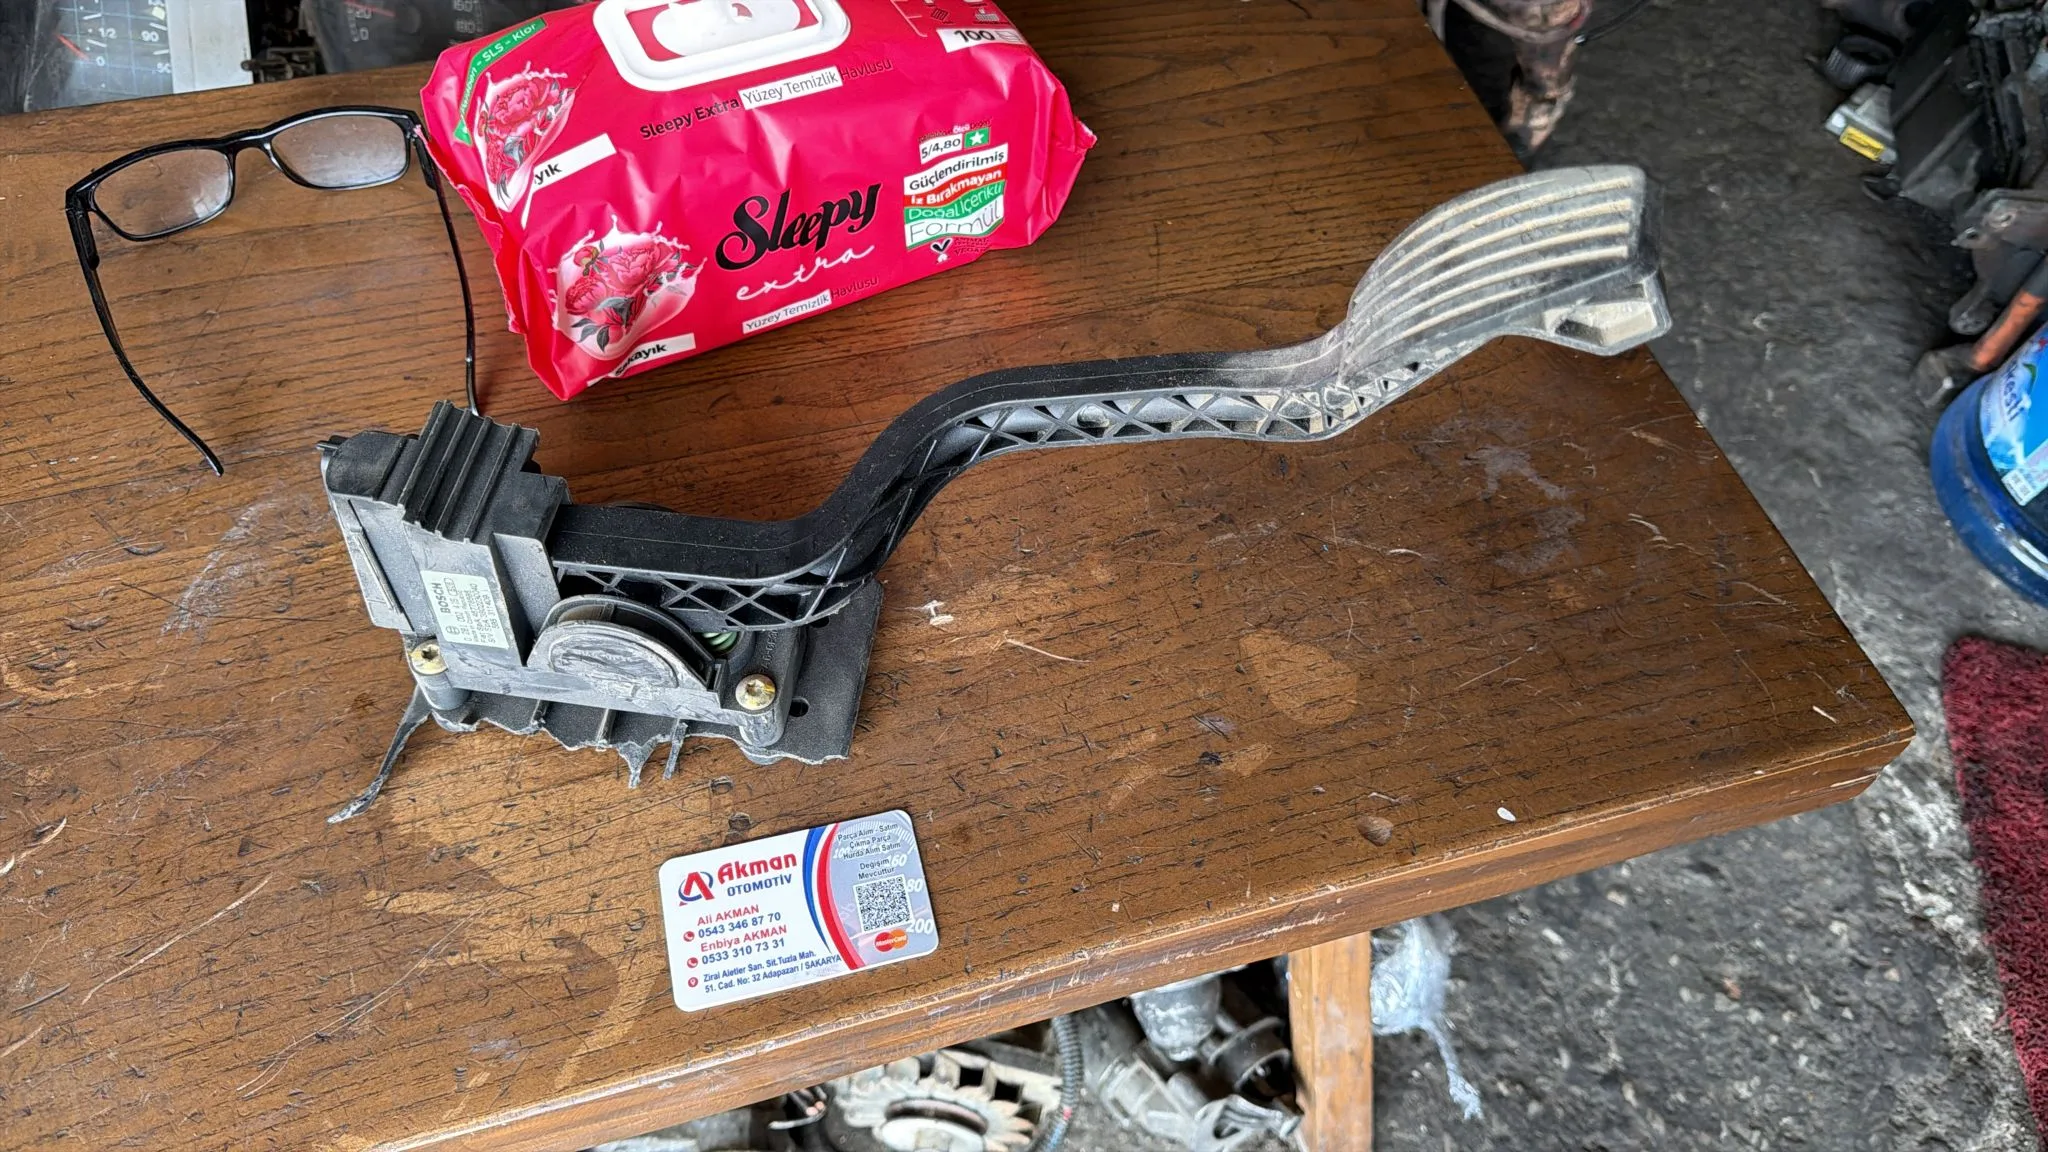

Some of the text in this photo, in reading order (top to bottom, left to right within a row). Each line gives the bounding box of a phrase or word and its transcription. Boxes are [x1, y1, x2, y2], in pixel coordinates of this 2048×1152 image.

[482, 42, 504, 62] SLS
[511, 23, 537, 42] Klor
[954, 30, 996, 42] 100
[96, 56, 105, 66] 0
[639, 59, 893, 139] Sleepy Extra Yüzey Temizlik Havlusu
[534, 163, 562, 185] yık
[909, 150, 1005, 191] Güçlendirilmiş
[926, 169, 1002, 205] Bırakmayan
[908, 203, 960, 220] Doğal
[909, 199, 1001, 243] Formül
[715, 183, 882, 271] Sleepy
[736, 245, 875, 300] extra
[745, 276, 878, 331] Yüzey Temizlik Havlusu
[431, 582, 452, 614] BOSCH
[837, 833, 858, 842] Parça
[879, 823, 898, 832] Satım
[849, 834, 891, 849] Çıkma Parça
[843, 850, 864, 860] Hurda
[881, 842, 901, 852] Satım
[717, 853, 797, 885] Akman
[858, 867, 896, 880] Mevcuttur
[727, 873, 792, 897] OTOMOTİV
[697, 904, 760, 926] Ali AKMAN
[698, 911, 782, 938] 0543 346 87 70
[906, 919, 934, 934] 200
[701, 924, 787, 953] Enbiya AKMAN
[701, 937, 785, 965] 0533 310 73 31
[705, 984, 717, 993] 51.
[718, 980, 735, 990] Cad.
[737, 977, 750, 986] No:
[751, 973, 761, 982] 32
[762, 965, 800, 980] Adapazarı
[804, 954, 842, 970] SAKARYA
[722, 967, 746, 978] Aletler
[747, 963, 765, 972] San.
[798, 950, 817, 960] Mah.
